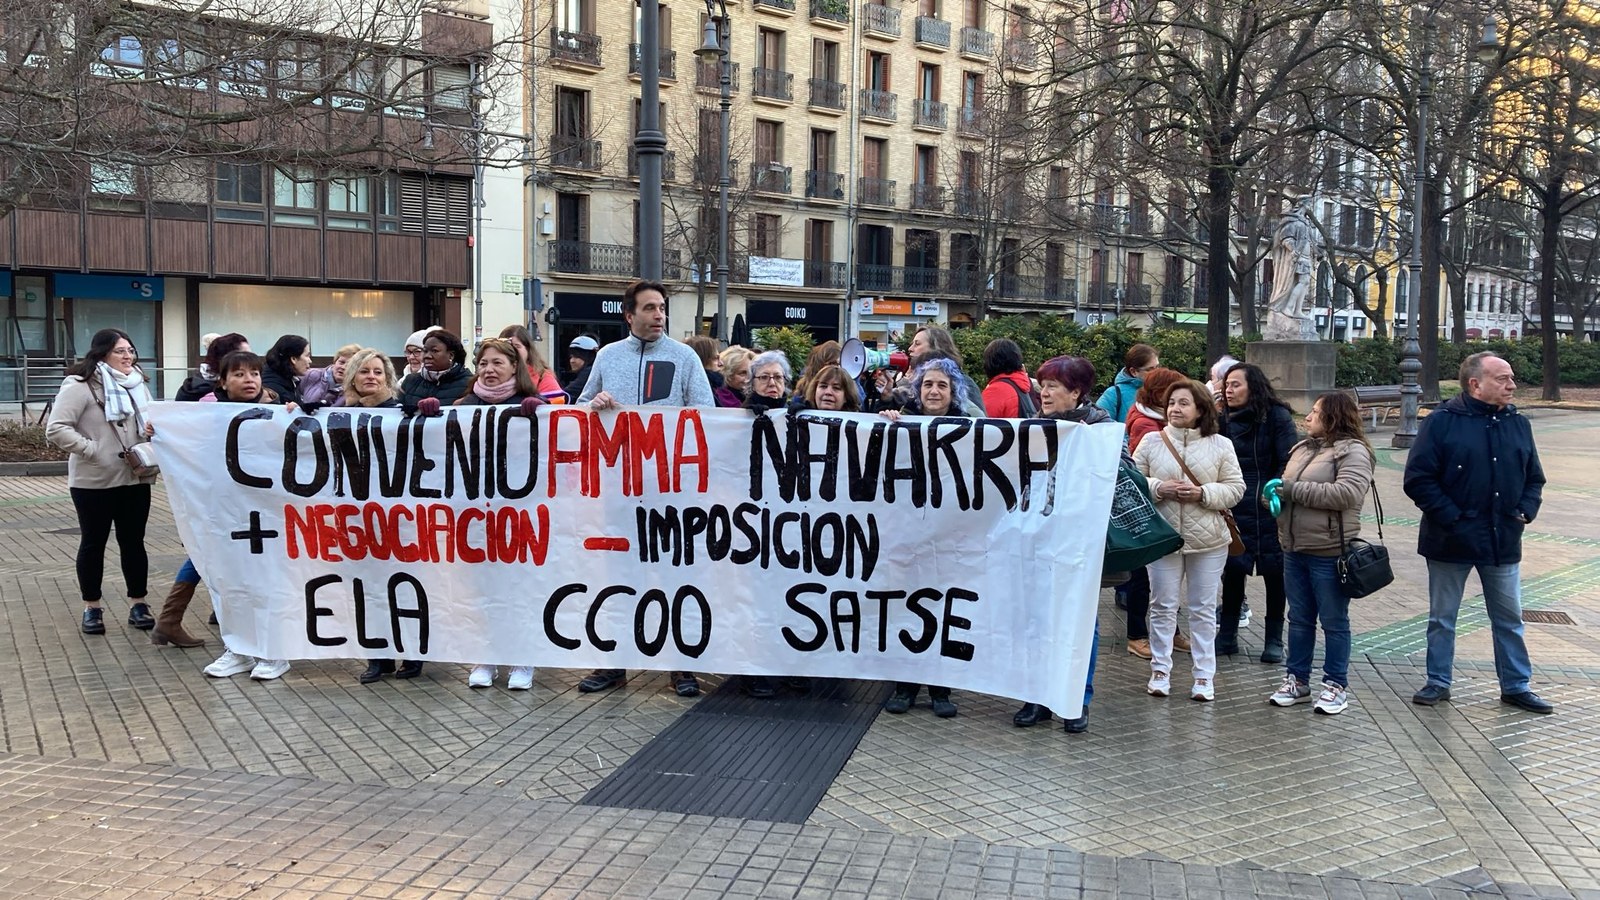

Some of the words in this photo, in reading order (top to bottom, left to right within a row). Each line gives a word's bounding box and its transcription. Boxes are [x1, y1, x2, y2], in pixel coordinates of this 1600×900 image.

[602, 300, 623, 314] GOIK
[785, 307, 807, 319] GOIKO
[225, 406, 538, 500] CONVENIO
[547, 408, 708, 498] AMMA
[749, 414, 1059, 516] NAVARRA
[284, 502, 550, 566] NEGOCIACION
[636, 501, 880, 582] IMPOSICION
[305, 571, 429, 654] ELA
[543, 582, 712, 658] CCOO
[781, 582, 979, 662] SATSE
